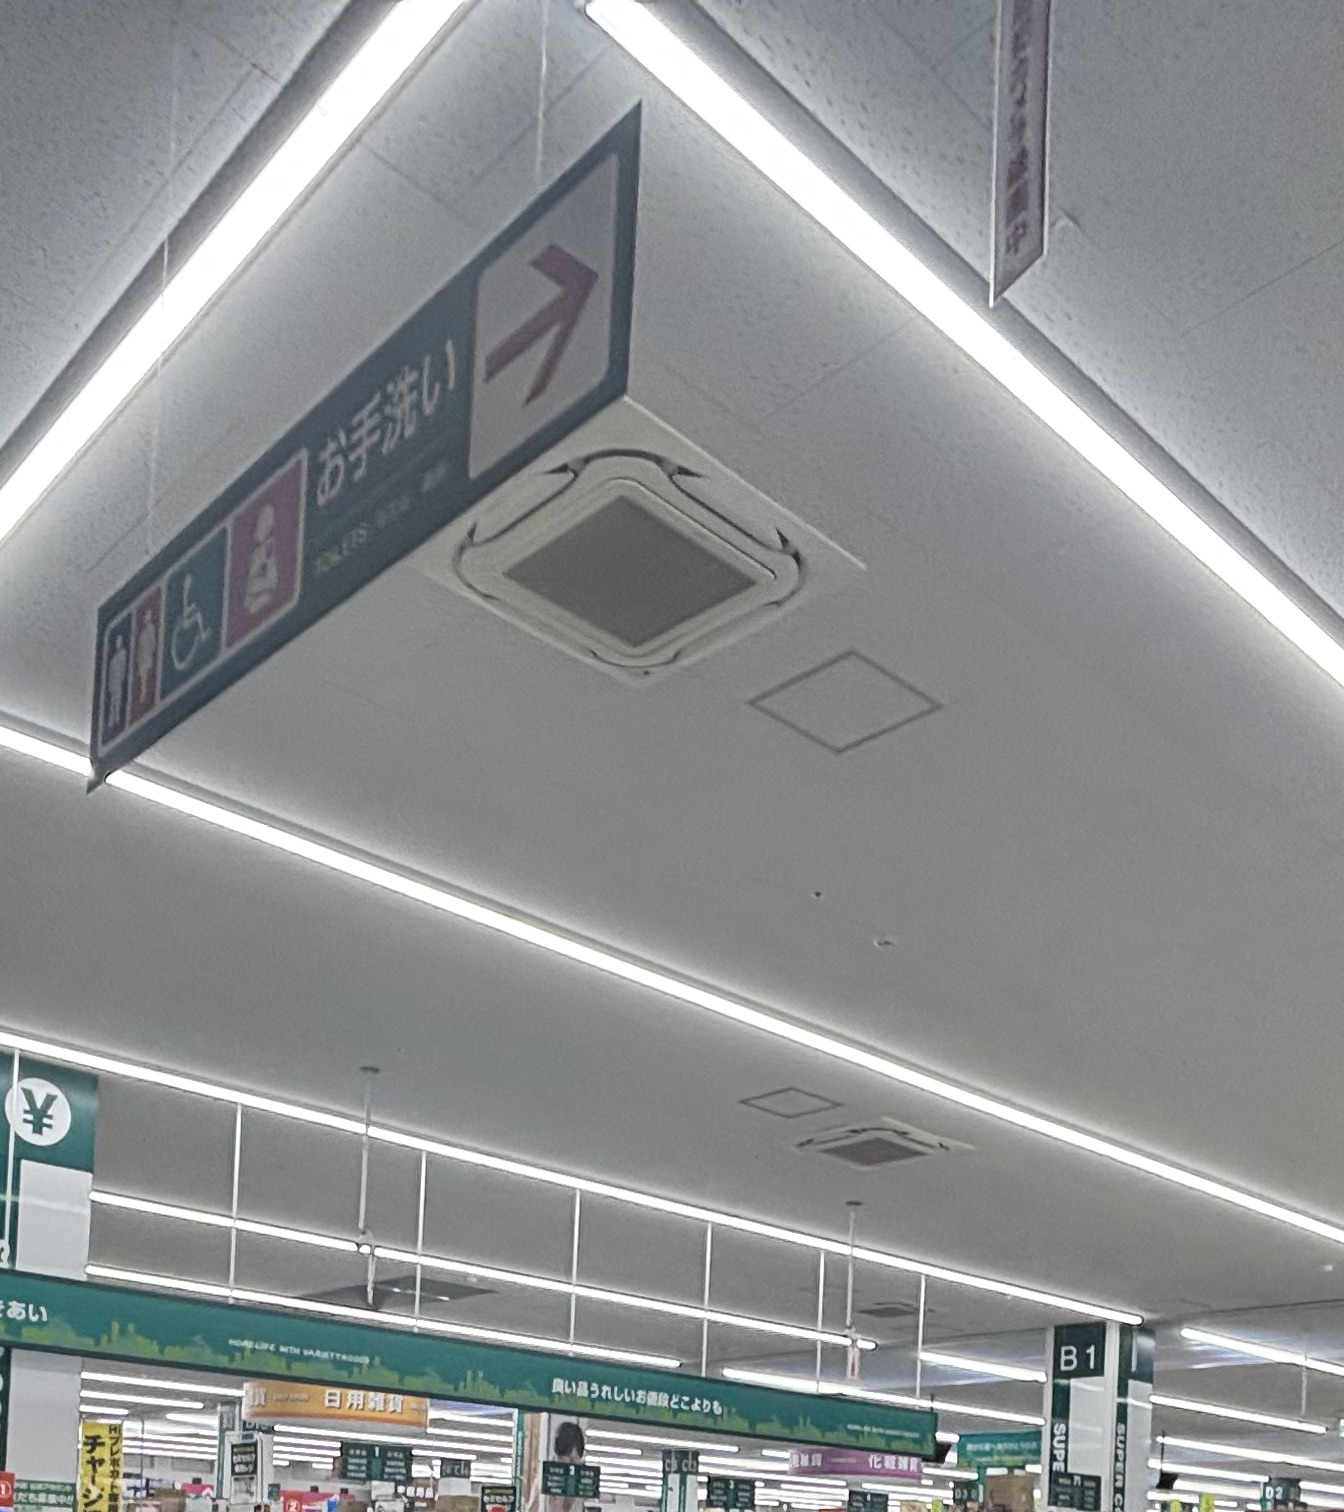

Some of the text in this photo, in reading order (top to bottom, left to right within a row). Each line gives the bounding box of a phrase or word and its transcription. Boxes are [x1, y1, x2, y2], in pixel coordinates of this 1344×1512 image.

[316, 339, 455, 506] お手洗い
[324, 1388, 404, 1413] 日用雑貨
[551, 1377, 724, 1416] 良い品うれしいお値段どこよりも
